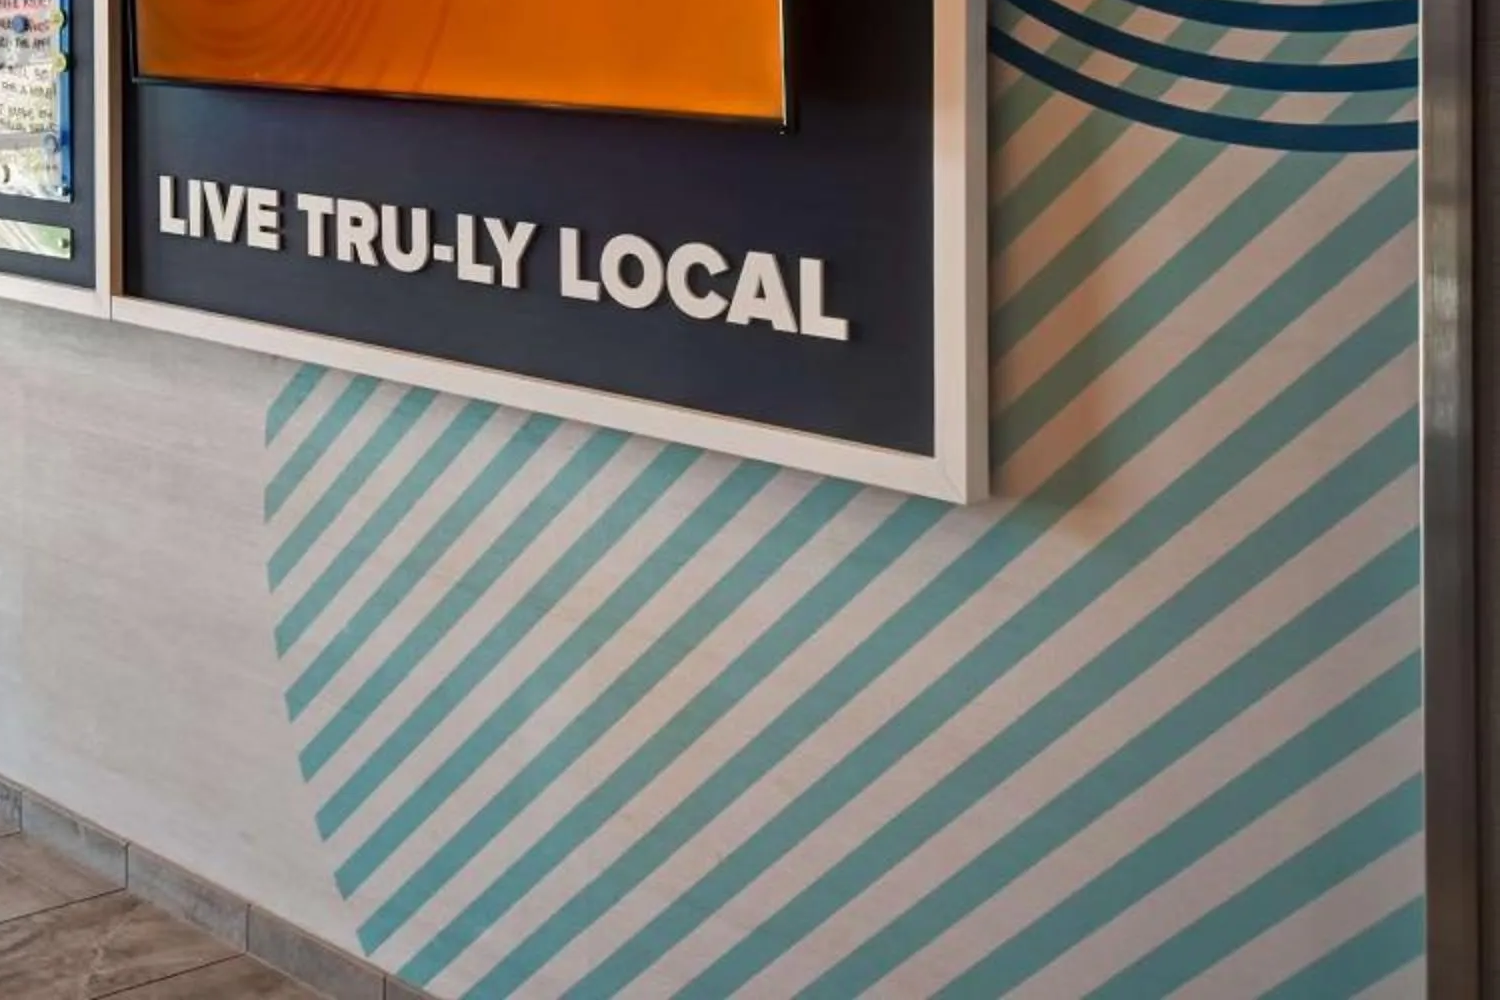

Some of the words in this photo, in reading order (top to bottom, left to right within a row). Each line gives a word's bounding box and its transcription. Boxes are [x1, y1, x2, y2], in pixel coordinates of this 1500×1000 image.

[158, 173, 282, 252] LIVE
[297, 192, 538, 290] TRU-LY
[559, 227, 850, 342] LOCAL
